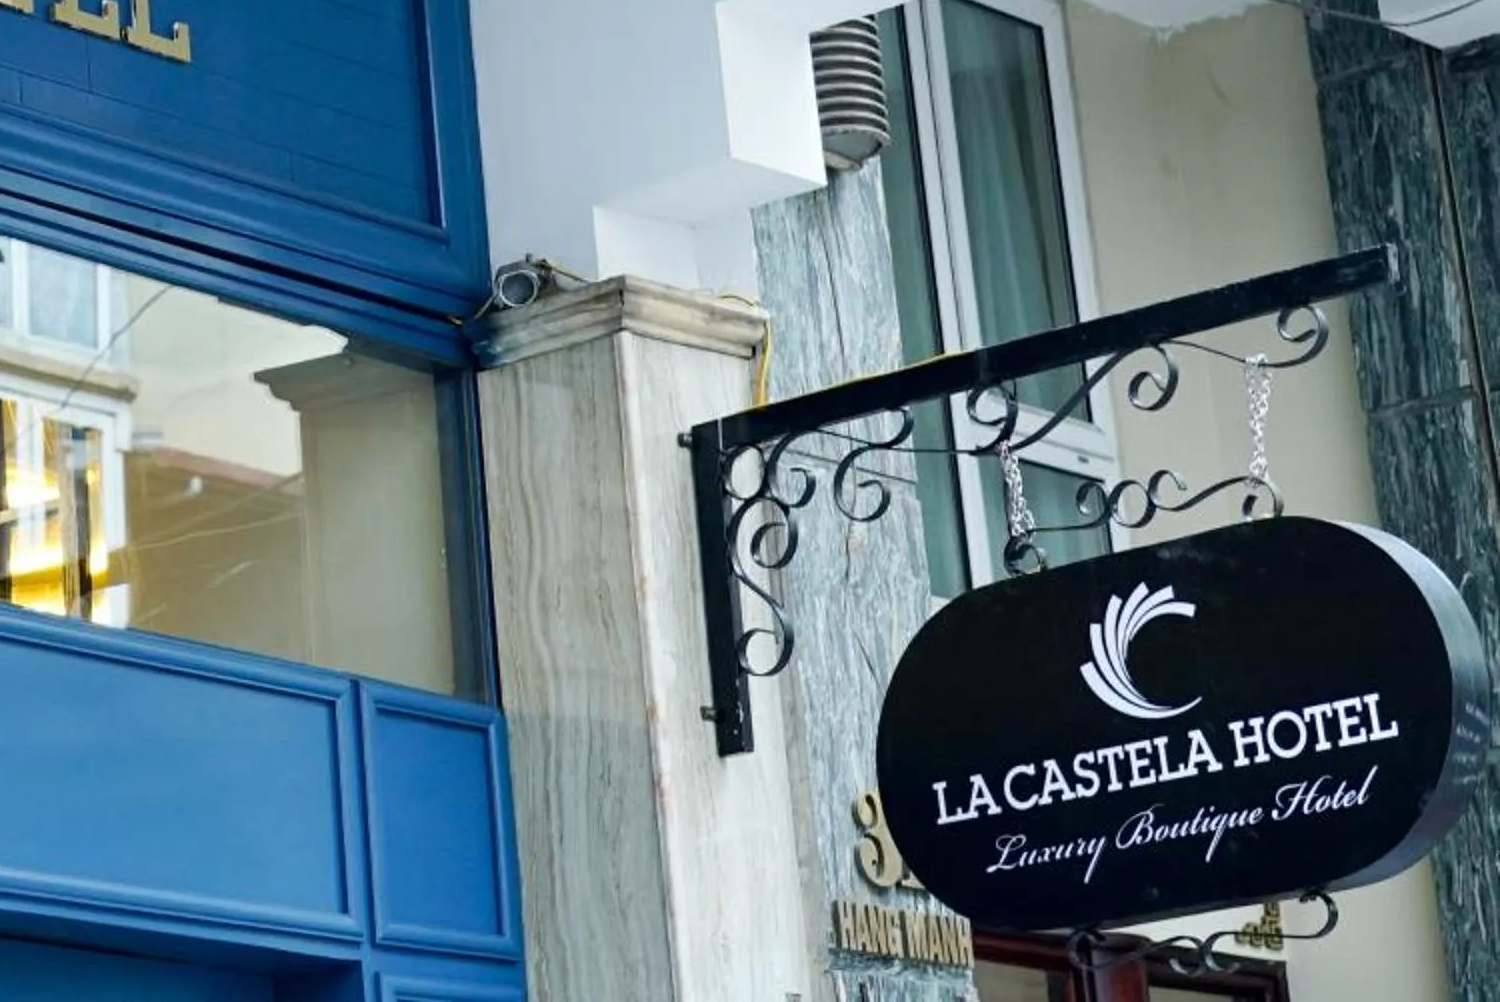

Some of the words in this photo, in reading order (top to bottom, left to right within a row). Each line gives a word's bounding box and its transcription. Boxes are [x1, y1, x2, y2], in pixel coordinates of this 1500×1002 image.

[1227, 693, 1400, 768] HOTEL
[986, 834, 1106, 885] Luxury
[1114, 803, 1265, 863] Boutique
[1270, 764, 1379, 821] Hotel
[834, 899, 904, 959] HANG
[905, 909, 975, 970] MANH
